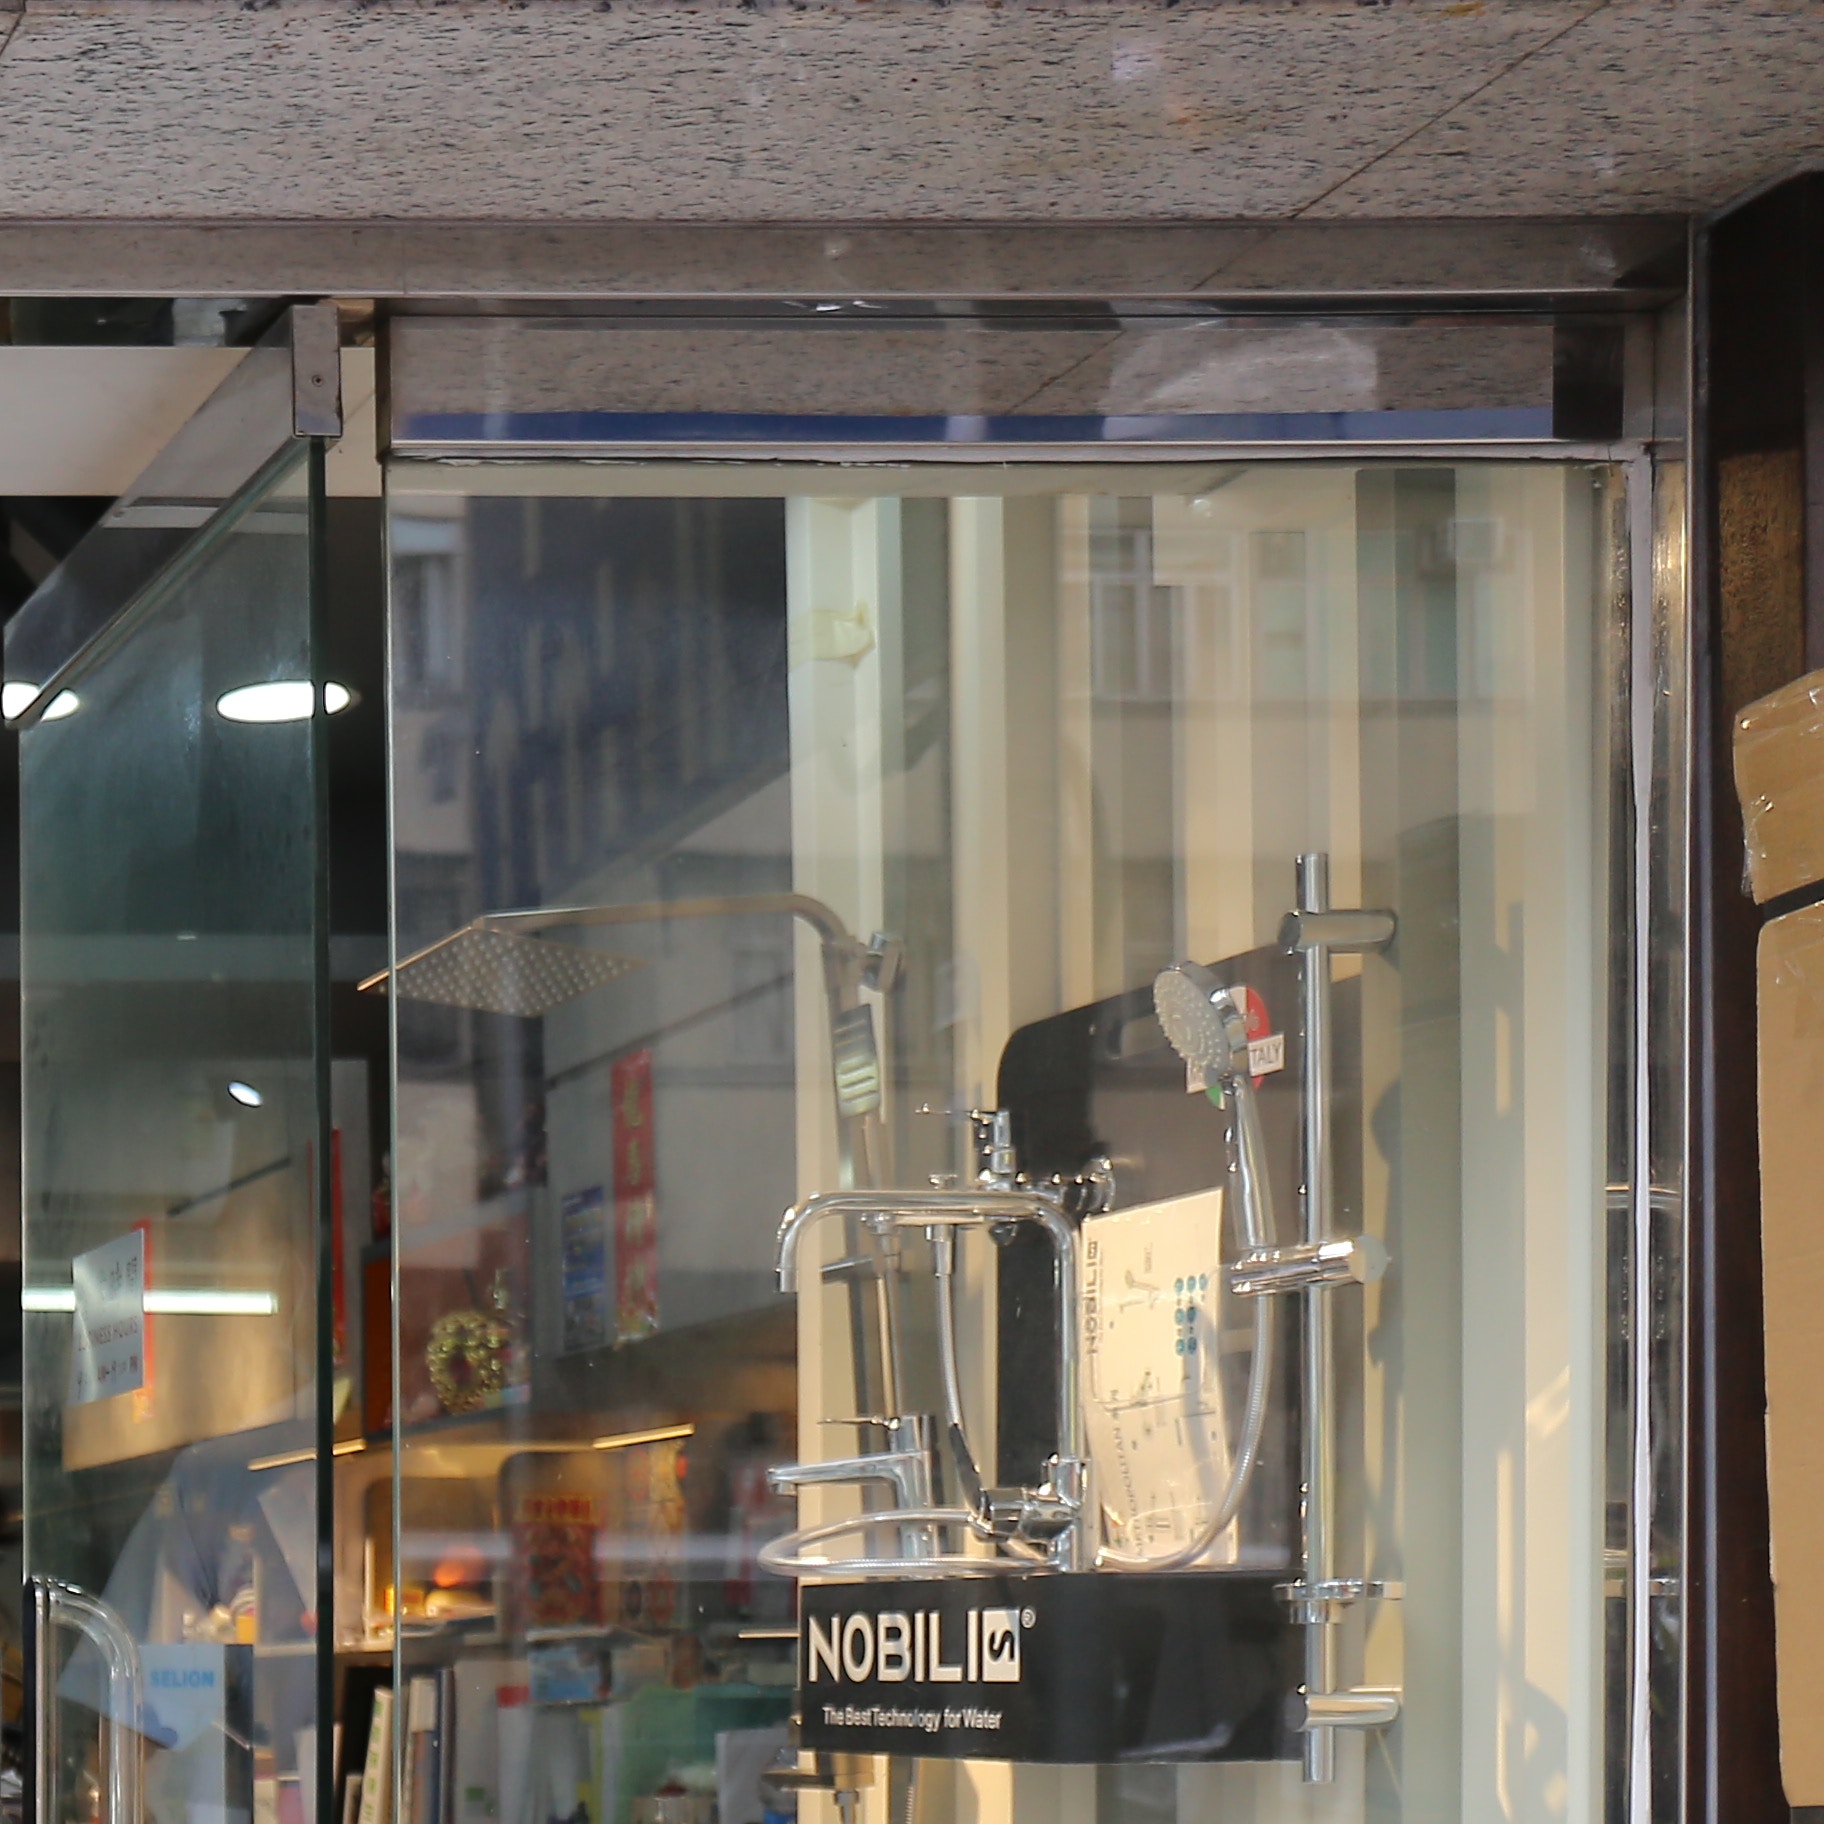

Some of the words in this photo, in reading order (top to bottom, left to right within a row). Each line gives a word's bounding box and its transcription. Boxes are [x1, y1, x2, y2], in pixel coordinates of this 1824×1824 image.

[822, 1704, 843, 1725] The
[844, 1704, 871, 1726] Best
[872, 1704, 940, 1732] Technology
[943, 1706, 961, 1728] for
[962, 1707, 1003, 1730] Water
